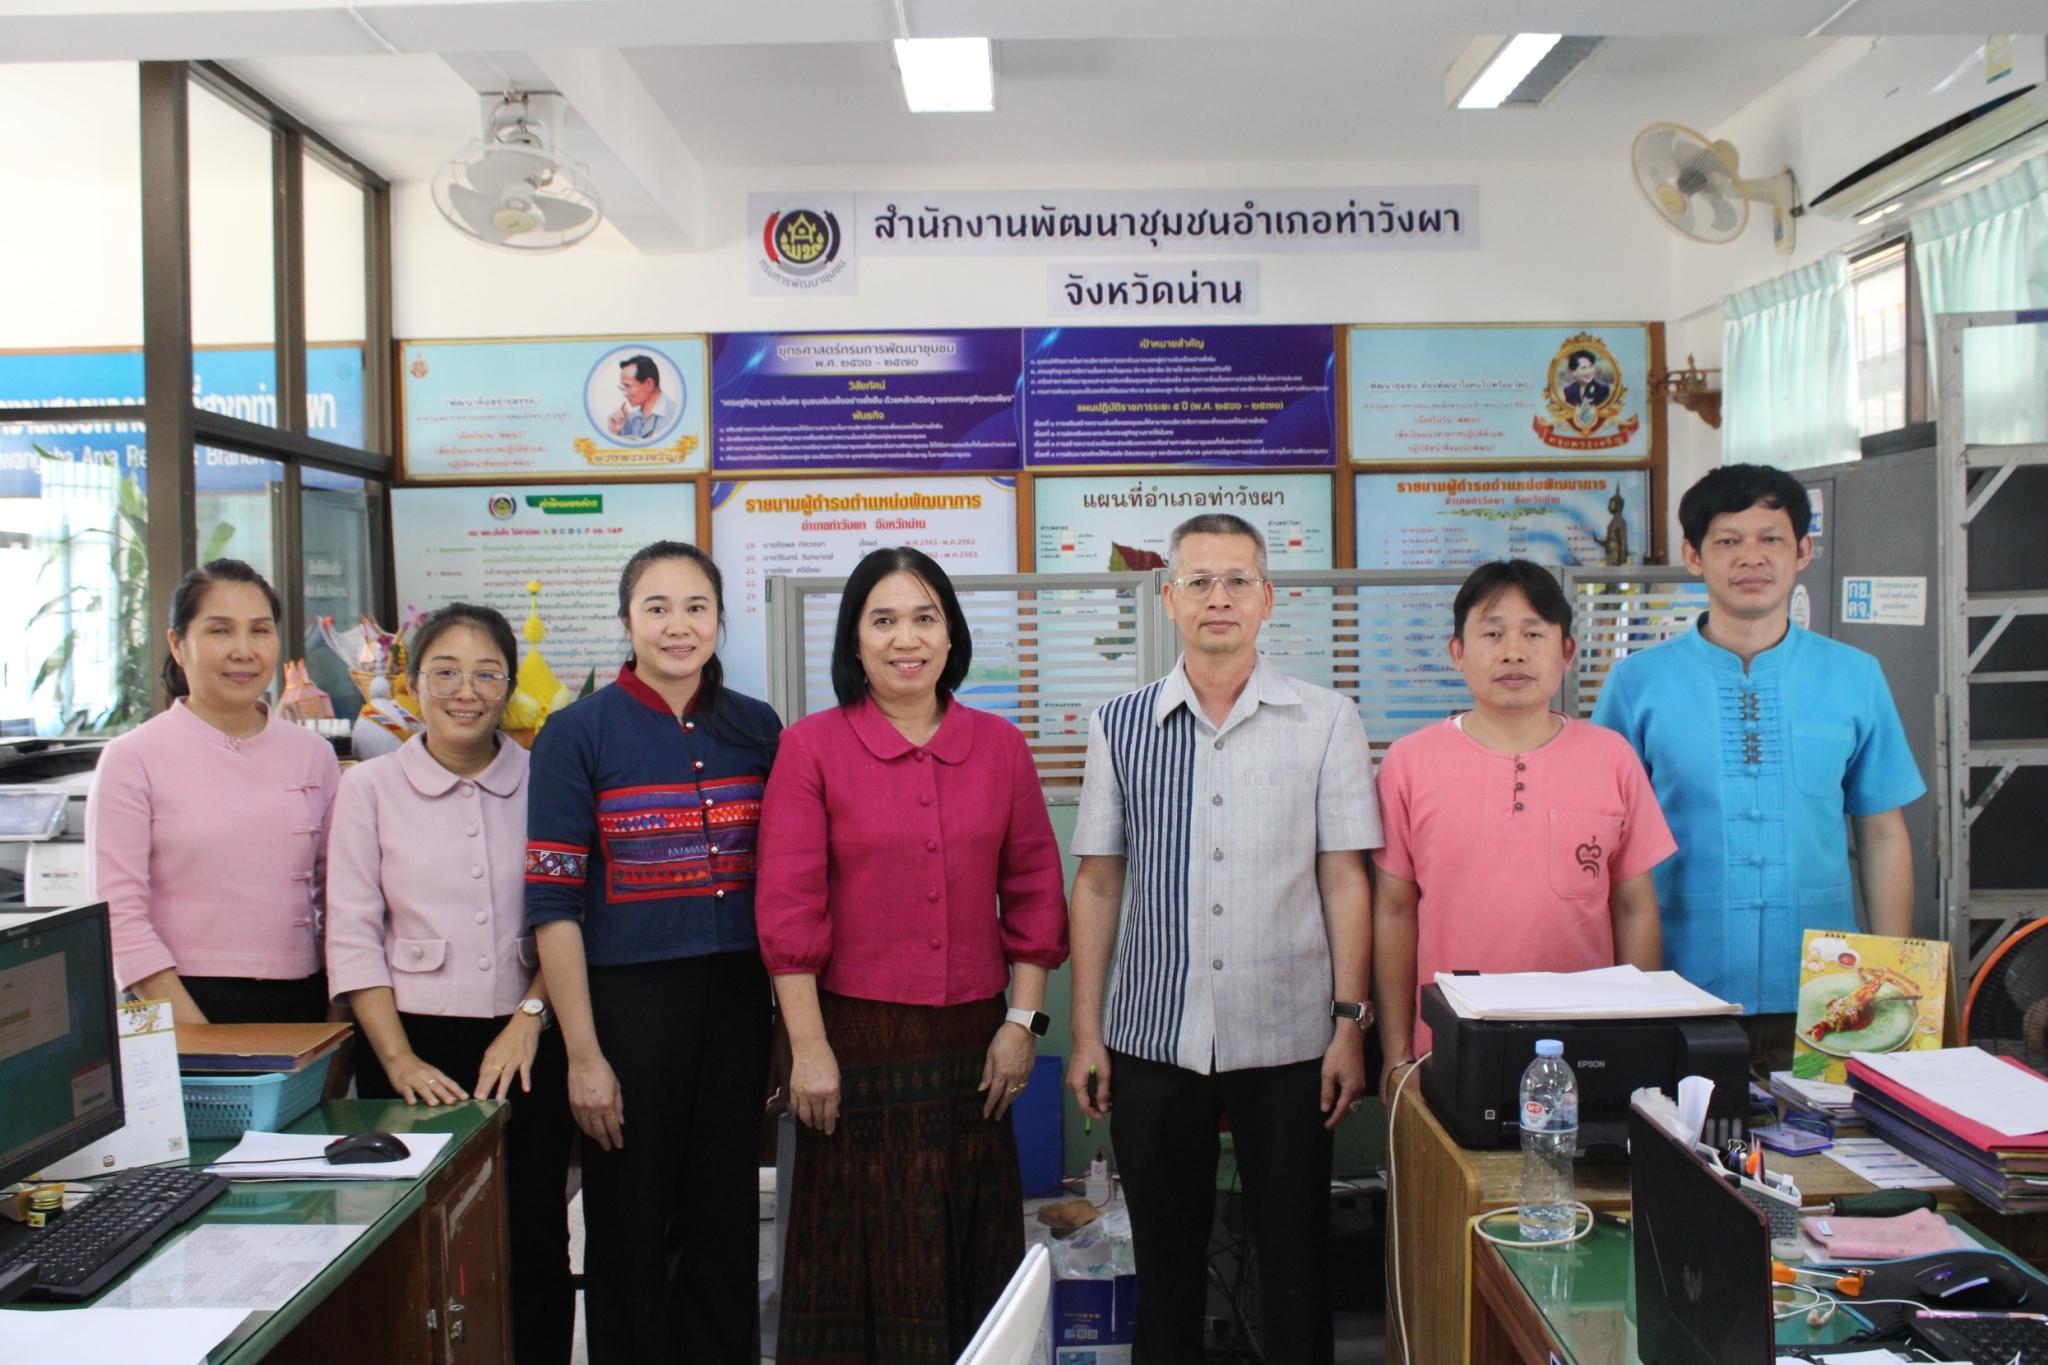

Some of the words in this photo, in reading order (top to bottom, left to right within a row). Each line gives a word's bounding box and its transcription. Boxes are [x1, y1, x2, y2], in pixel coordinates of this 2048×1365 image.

[874, 199, 1460, 247] สำนักงานพัฒนาชุมชนอำเภอท่าวังผา
[758, 258, 846, 289] กรมการพัฒนาชุมชน
[1064, 269, 1243, 305] จังหวัดน่าน
[778, 342, 955, 359] ยุทธศาสตร์กรมการพัฒนาชุมชน
[1139, 338, 1205, 349] เป้าหมายสำคัญ
[815, 359, 838, 368] พ.ศ.
[848, 380, 886, 391] วิสัยทัศน์
[852, 410, 885, 421] พันธกิจ
[1076, 401, 1171, 414] แผนปฏิบัติราชการระยะ
[1083, 481, 1285, 509] แผนที่อำเภอท่าวังผา
[1397, 480, 1608, 496] รายนามผู้ดำรงตำแหน่งพัฒนาการ
[745, 492, 982, 516] รายนามผู้ดำรงตำแหน่งพัฒนาการ
[801, 518, 867, 532] อำเภอท่าวังผา
[875, 517, 926, 530] จังหวัดน่าน
[1848, 582, 1871, 599] กข.
[1848, 601, 1871, 618] คจ.
[1577, 1060, 1606, 1068] EPSON
[1527, 1104, 1541, 1112] aro
